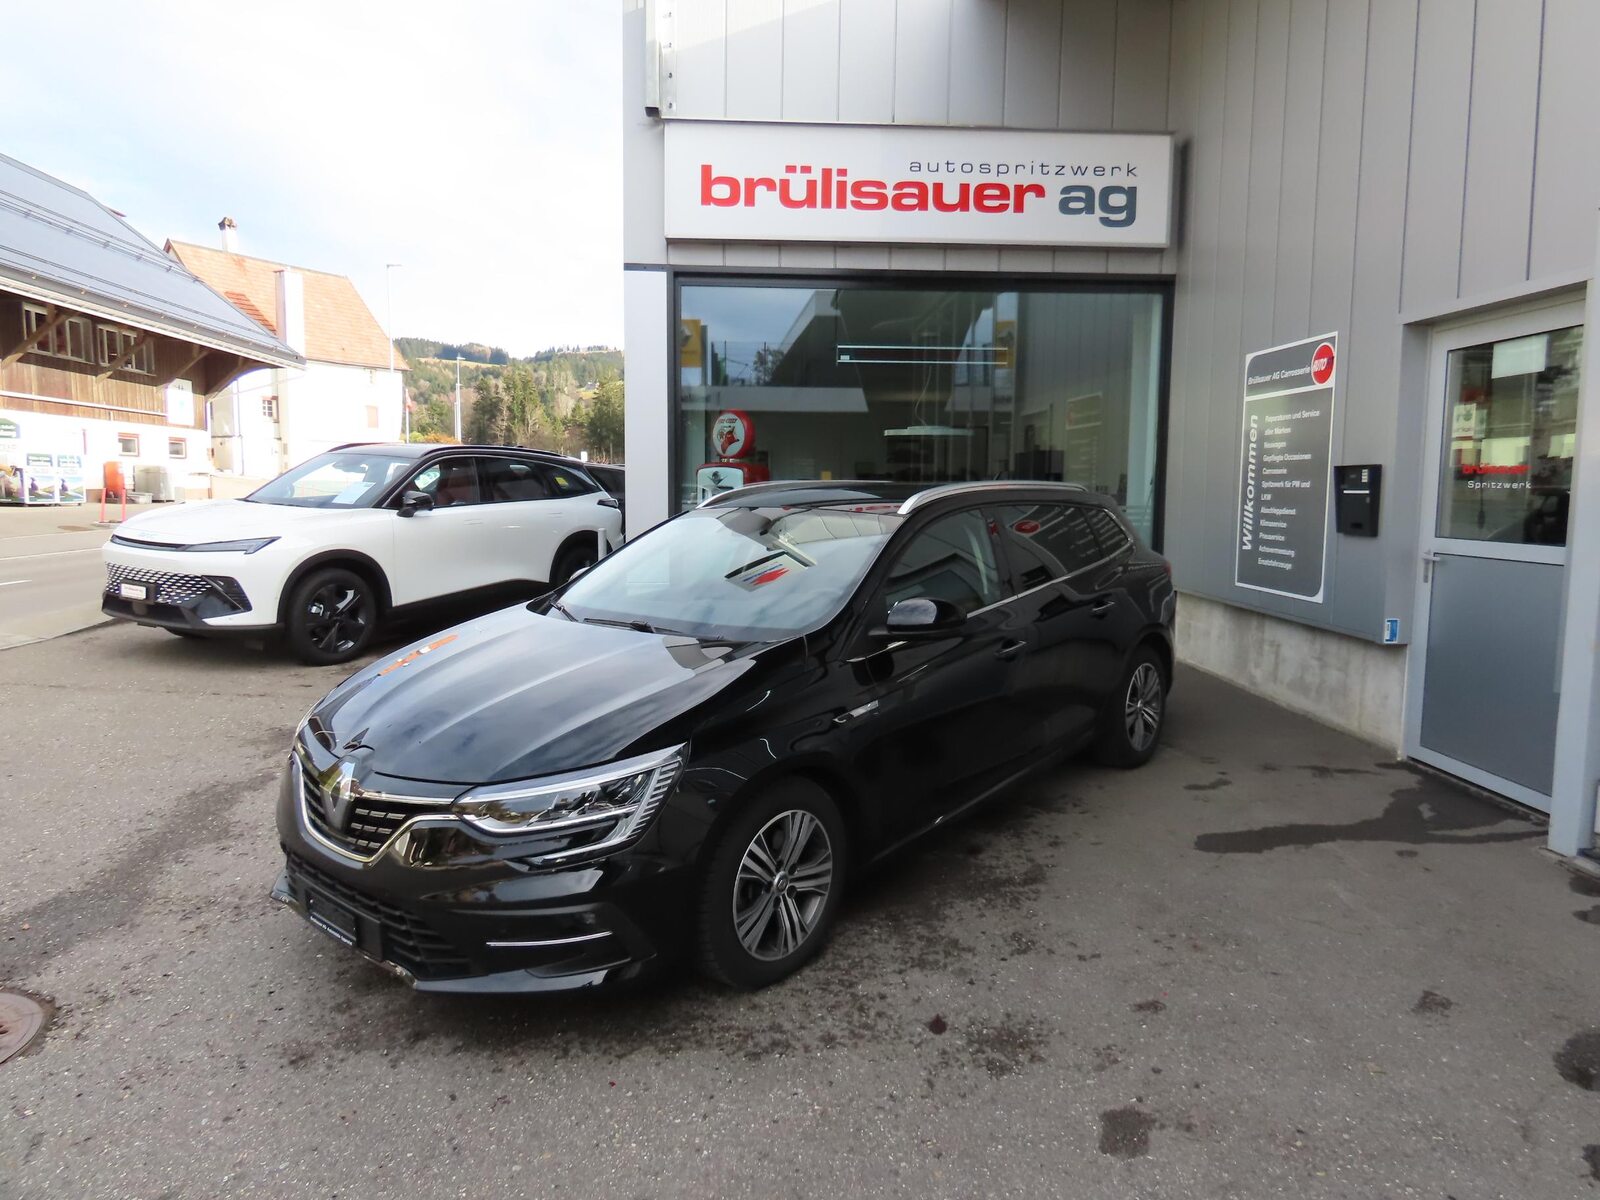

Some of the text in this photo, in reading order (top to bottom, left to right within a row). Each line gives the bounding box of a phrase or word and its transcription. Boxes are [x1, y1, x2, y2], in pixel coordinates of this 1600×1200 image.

[909, 159, 1138, 178] autospritzwerk
[700, 163, 1138, 228] brülisauer ag
[1272, 370, 1280, 381] AG
[1280, 365, 1311, 379] Carrosserie
[1292, 411, 1301, 420] und
[1301, 409, 1320, 418] Service
[1241, 414, 1258, 550] Willkommen
[1284, 480, 1292, 488] für
[1300, 480, 1311, 488] und
[1467, 480, 1532, 490] Spritzwerk
[1261, 493, 1272, 501] LKW
